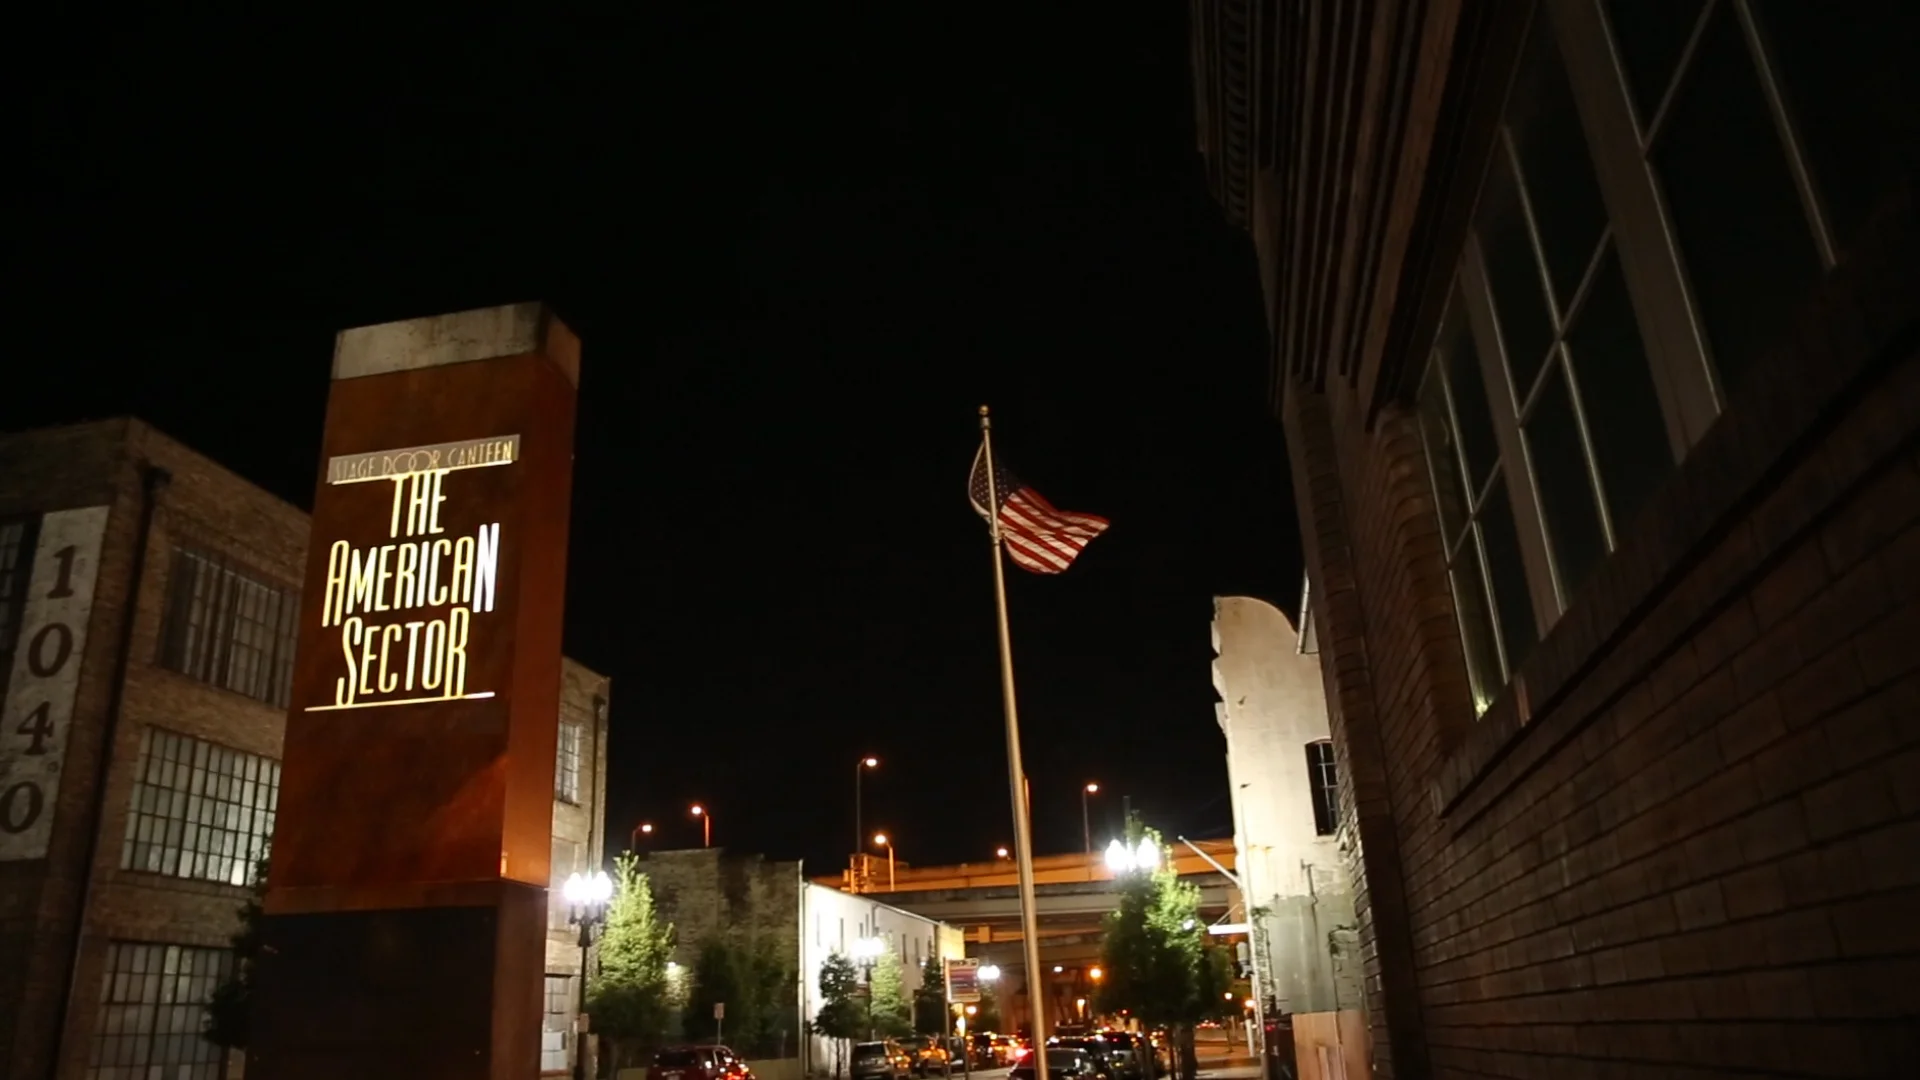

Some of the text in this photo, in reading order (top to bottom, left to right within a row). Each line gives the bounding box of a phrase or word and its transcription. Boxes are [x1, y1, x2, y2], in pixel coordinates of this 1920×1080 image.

[334, 441, 513, 480] STAGE DOOR CANTEEN
[390, 469, 450, 538] THE
[322, 523, 500, 627] AMERICAN
[0, 544, 77, 834] 1040
[336, 607, 470, 706] SECTOR
